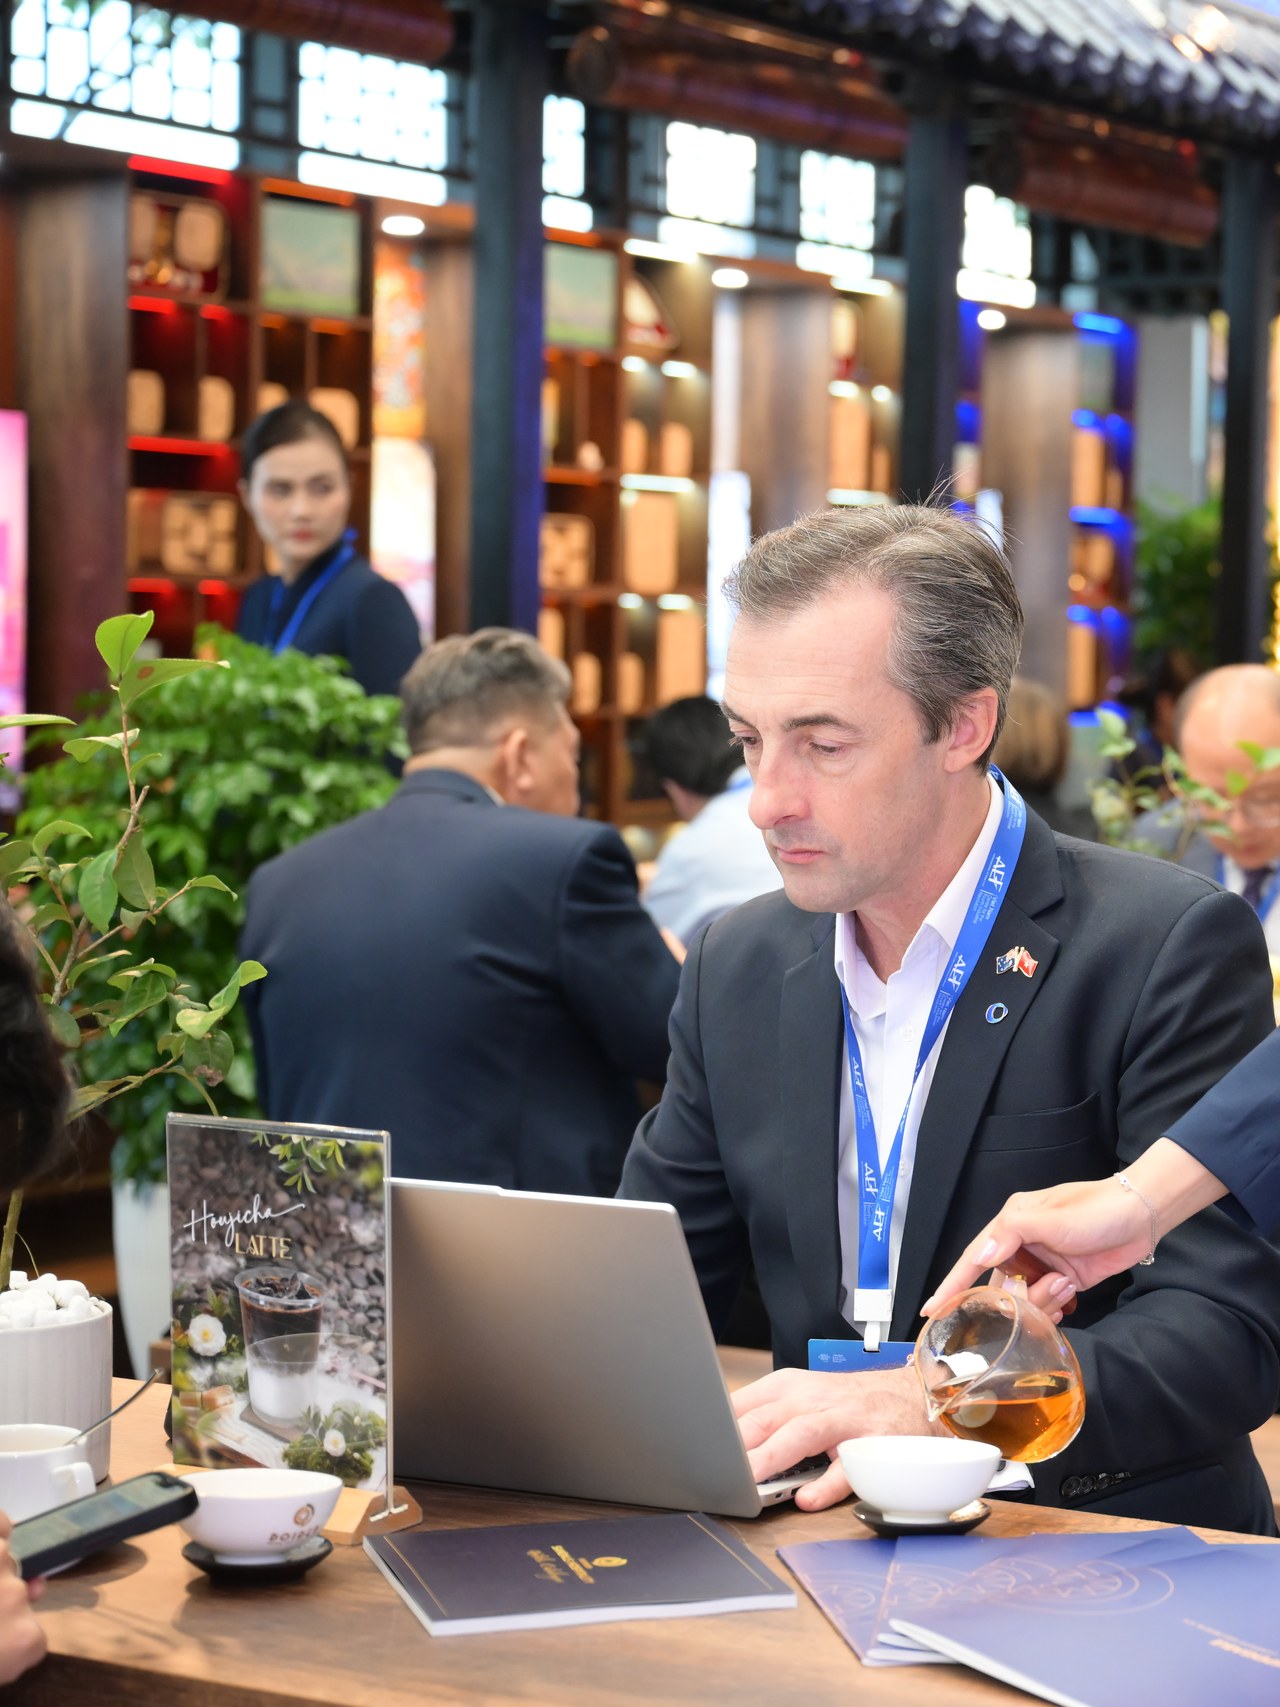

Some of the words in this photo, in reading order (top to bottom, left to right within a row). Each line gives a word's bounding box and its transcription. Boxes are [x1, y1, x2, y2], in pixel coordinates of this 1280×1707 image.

[988, 855, 1006, 892] AEF
[948, 954, 967, 993] AEF
[183, 1194, 306, 1247] Houjicha
[872, 1202, 886, 1242] AEF
[235, 1233, 293, 1259] LATTE
